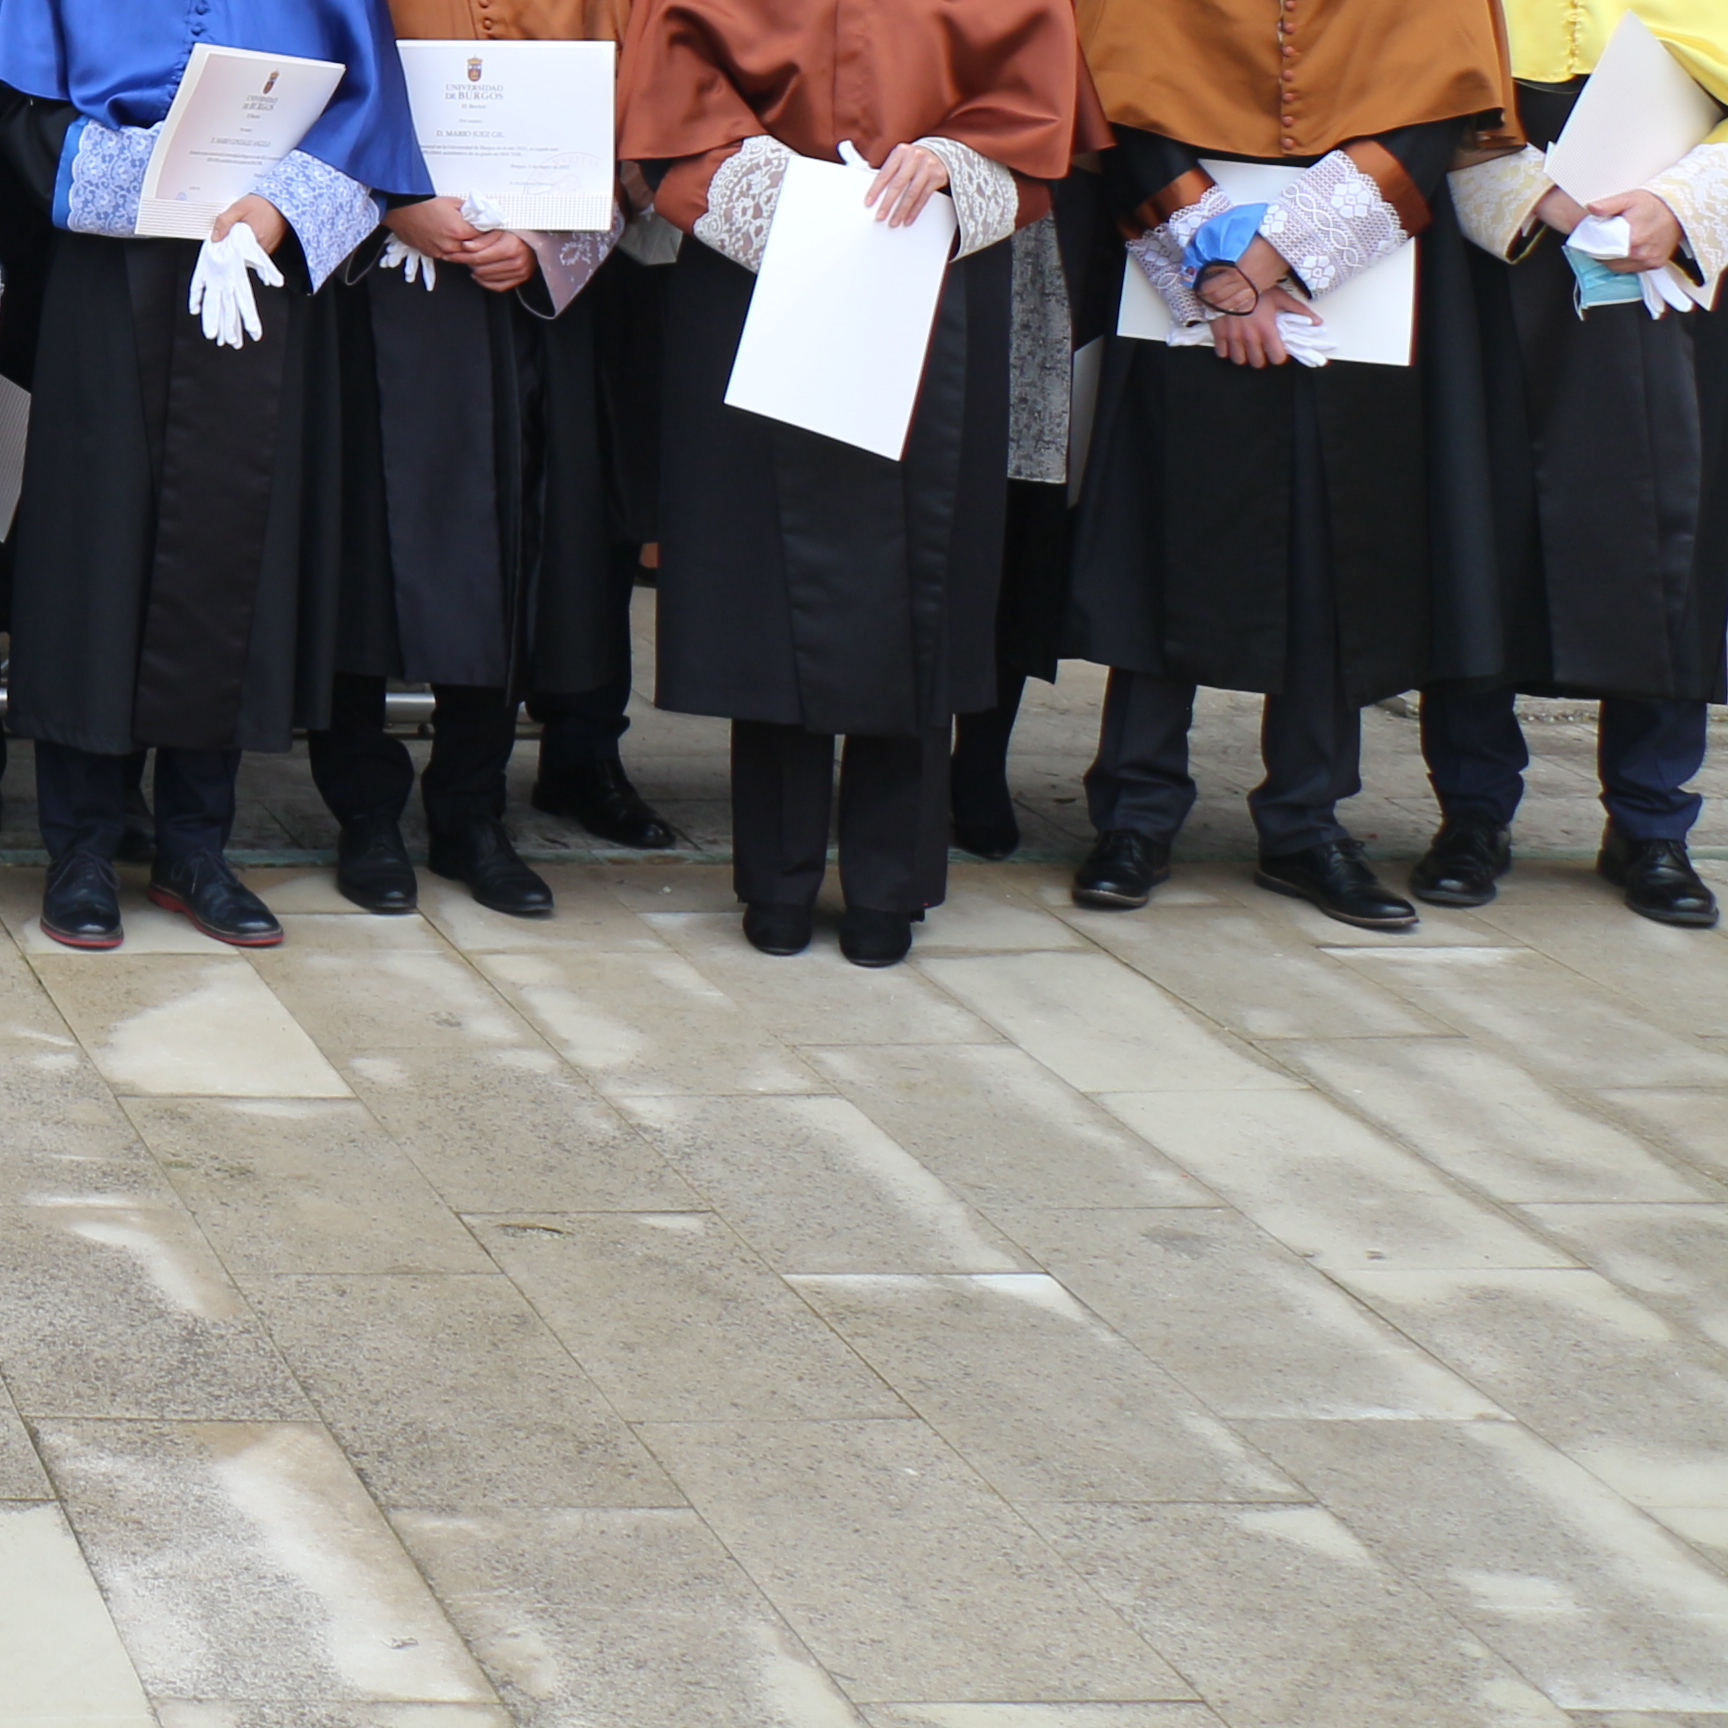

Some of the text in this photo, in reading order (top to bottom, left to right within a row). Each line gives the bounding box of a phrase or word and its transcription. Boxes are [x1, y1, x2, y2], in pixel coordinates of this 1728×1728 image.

[444, 84, 504, 92] UNIVERSIDAD
[444, 91, 504, 100] DE BURGOS
